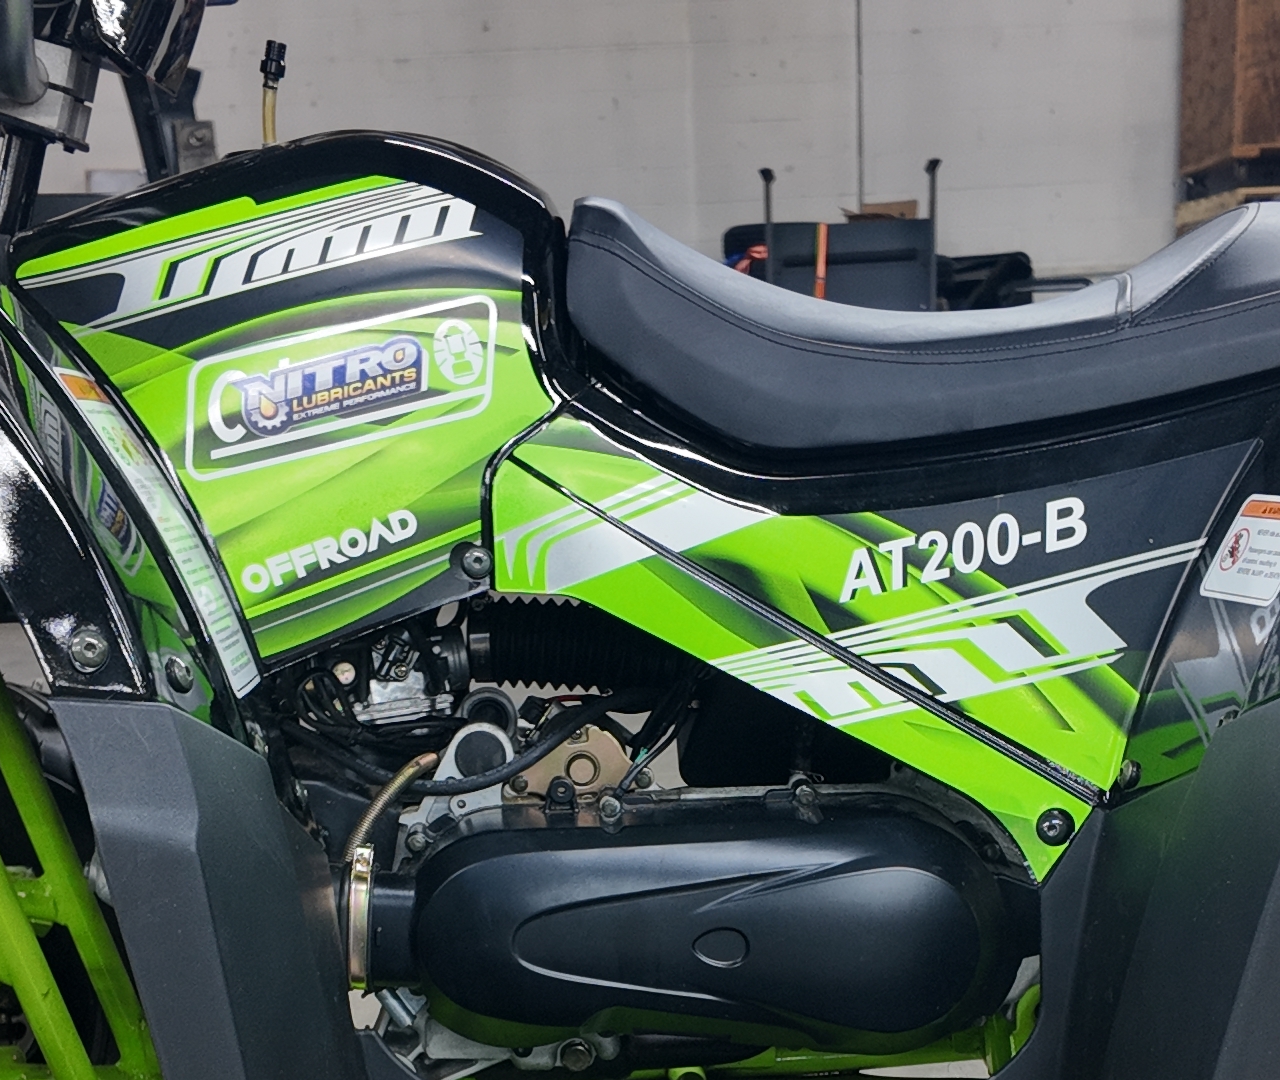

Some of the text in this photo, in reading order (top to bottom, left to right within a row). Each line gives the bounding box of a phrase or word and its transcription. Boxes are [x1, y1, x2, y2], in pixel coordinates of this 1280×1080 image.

[244, 343, 417, 408] NITRO
[293, 368, 417, 411] LUBRICANTS
[293, 382, 417, 421] EXTREME PERFORMANCE
[241, 509, 418, 594] OFFROAD
[839, 497, 1088, 603] AT200-B
